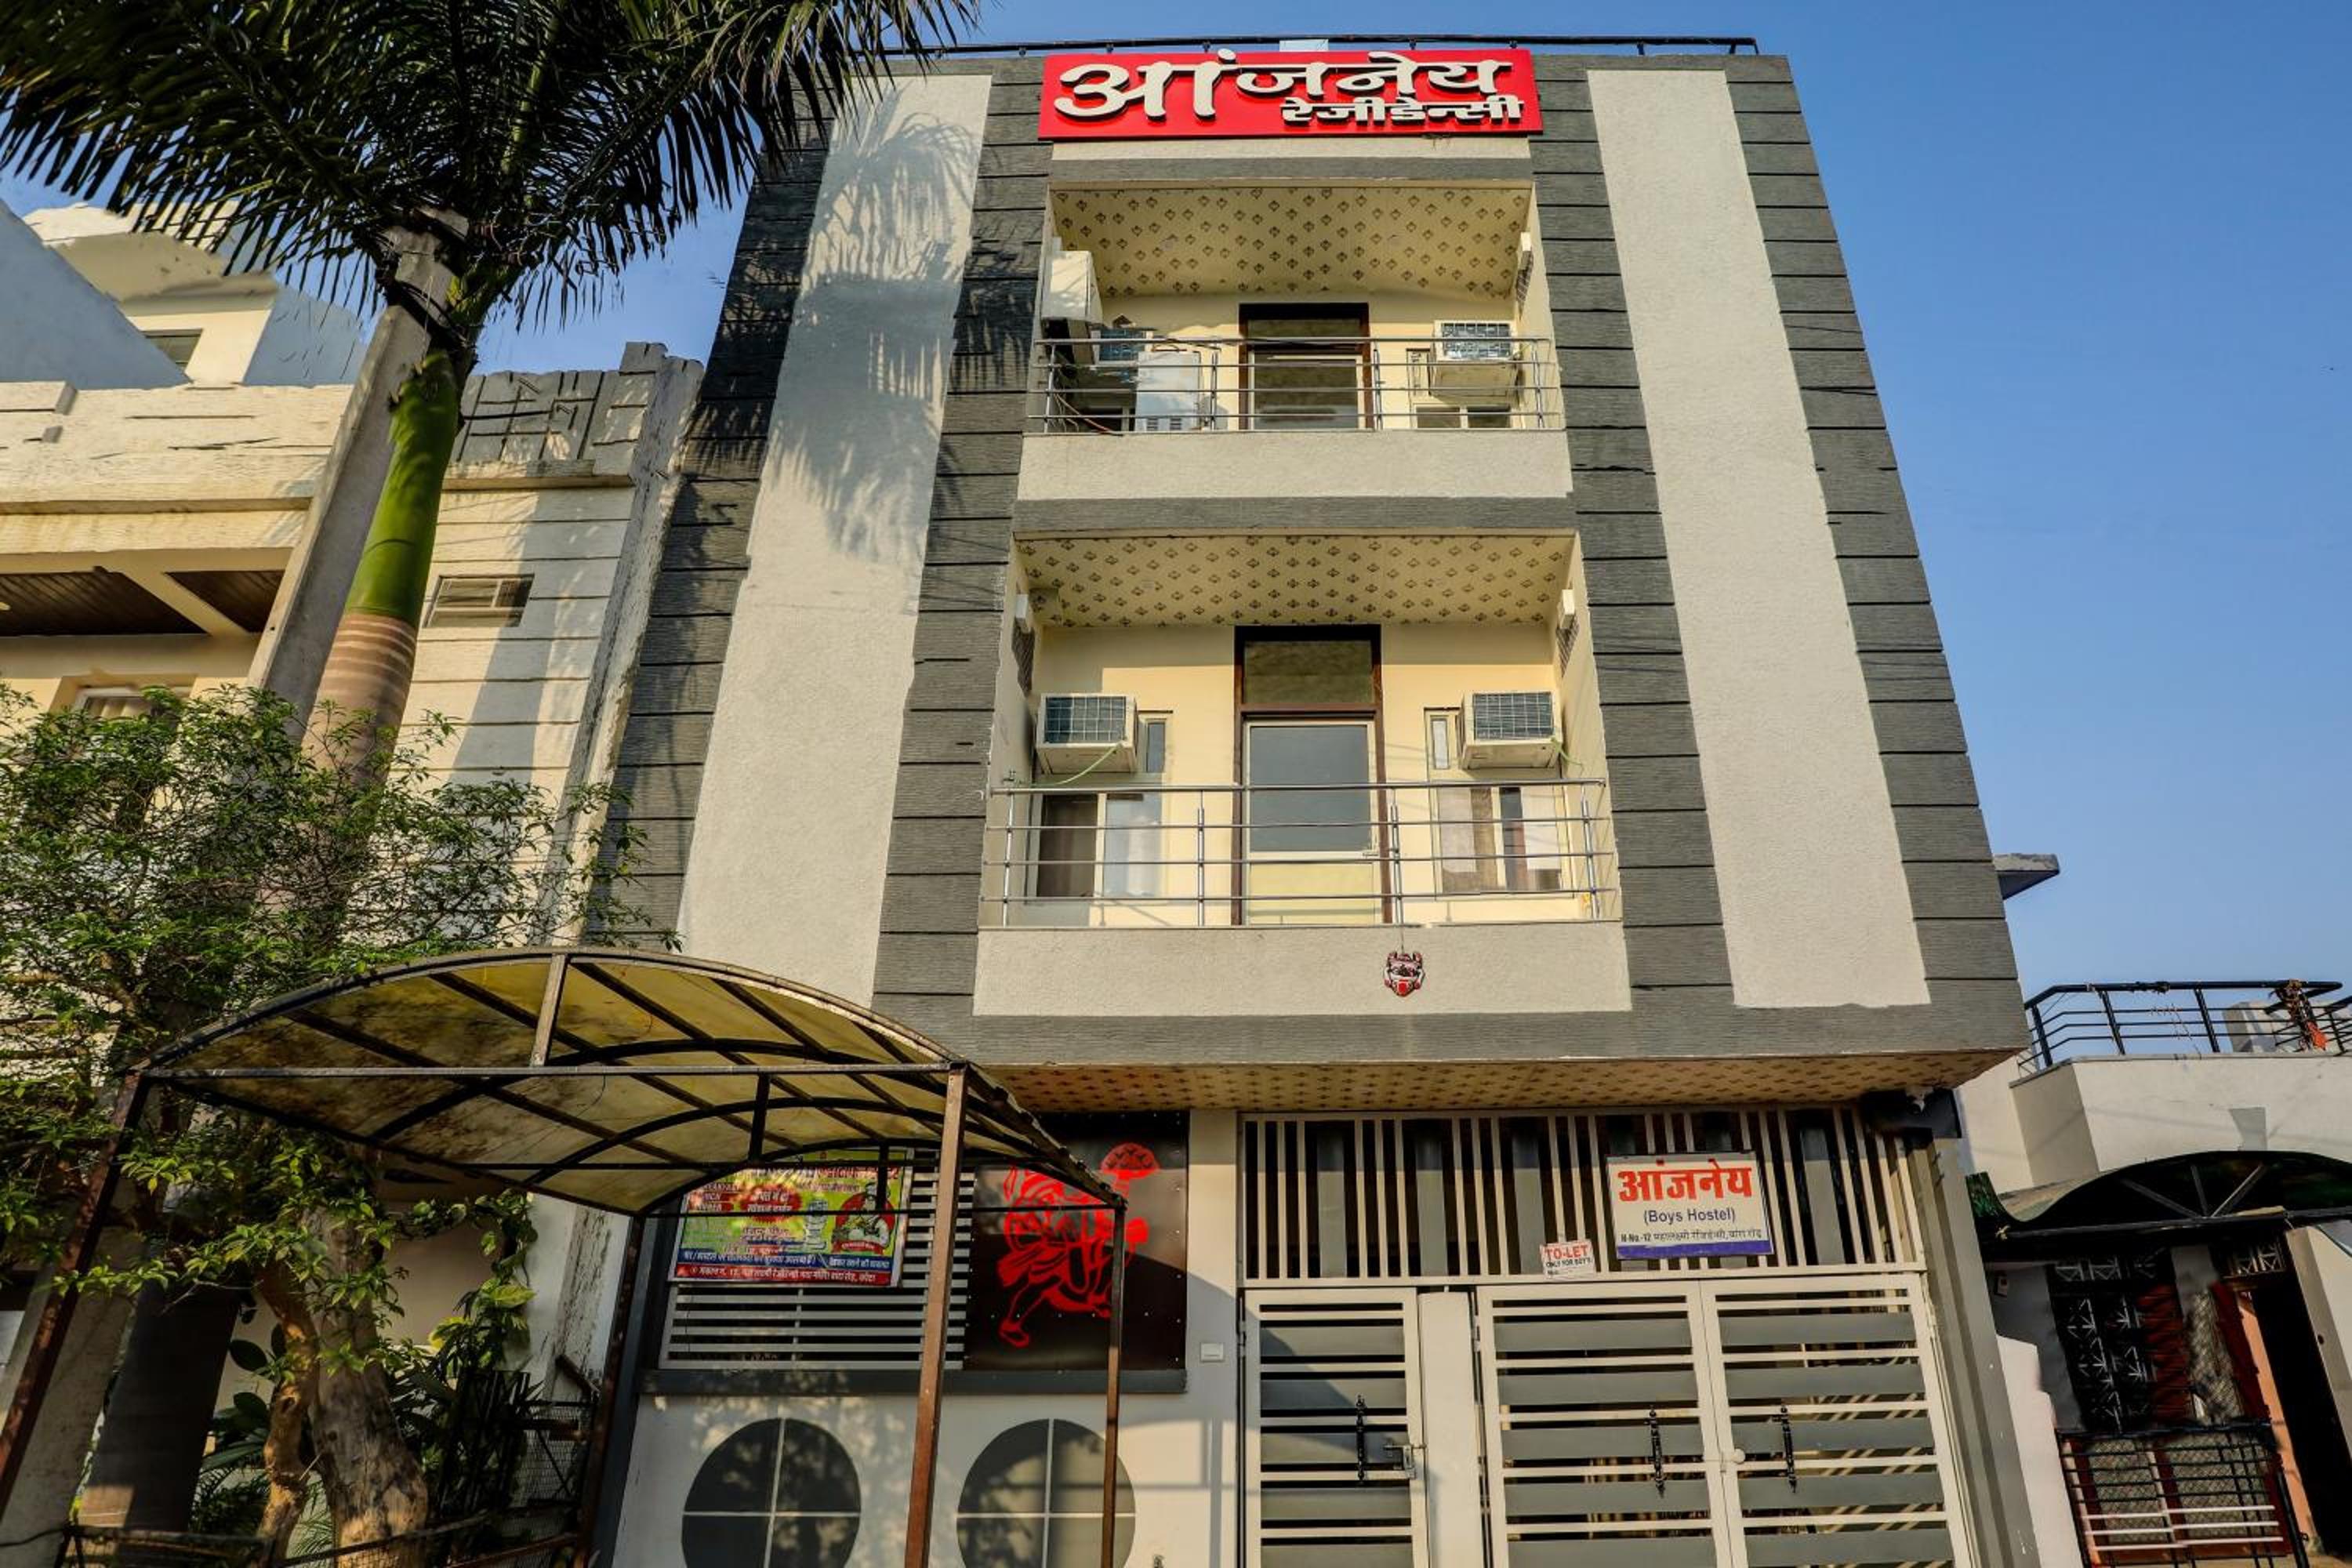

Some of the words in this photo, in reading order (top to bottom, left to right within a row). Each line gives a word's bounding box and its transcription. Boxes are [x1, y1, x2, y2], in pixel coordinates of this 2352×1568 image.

[1054, 49, 1513, 121] आंजनेय
[1279, 95, 1525, 125] रेजीडेन्सी
[1617, 1158, 1752, 1202] आंजनेय
[1644, 1210, 1682, 1225] (Boys
[1687, 1207, 1736, 1223] Hostel)
